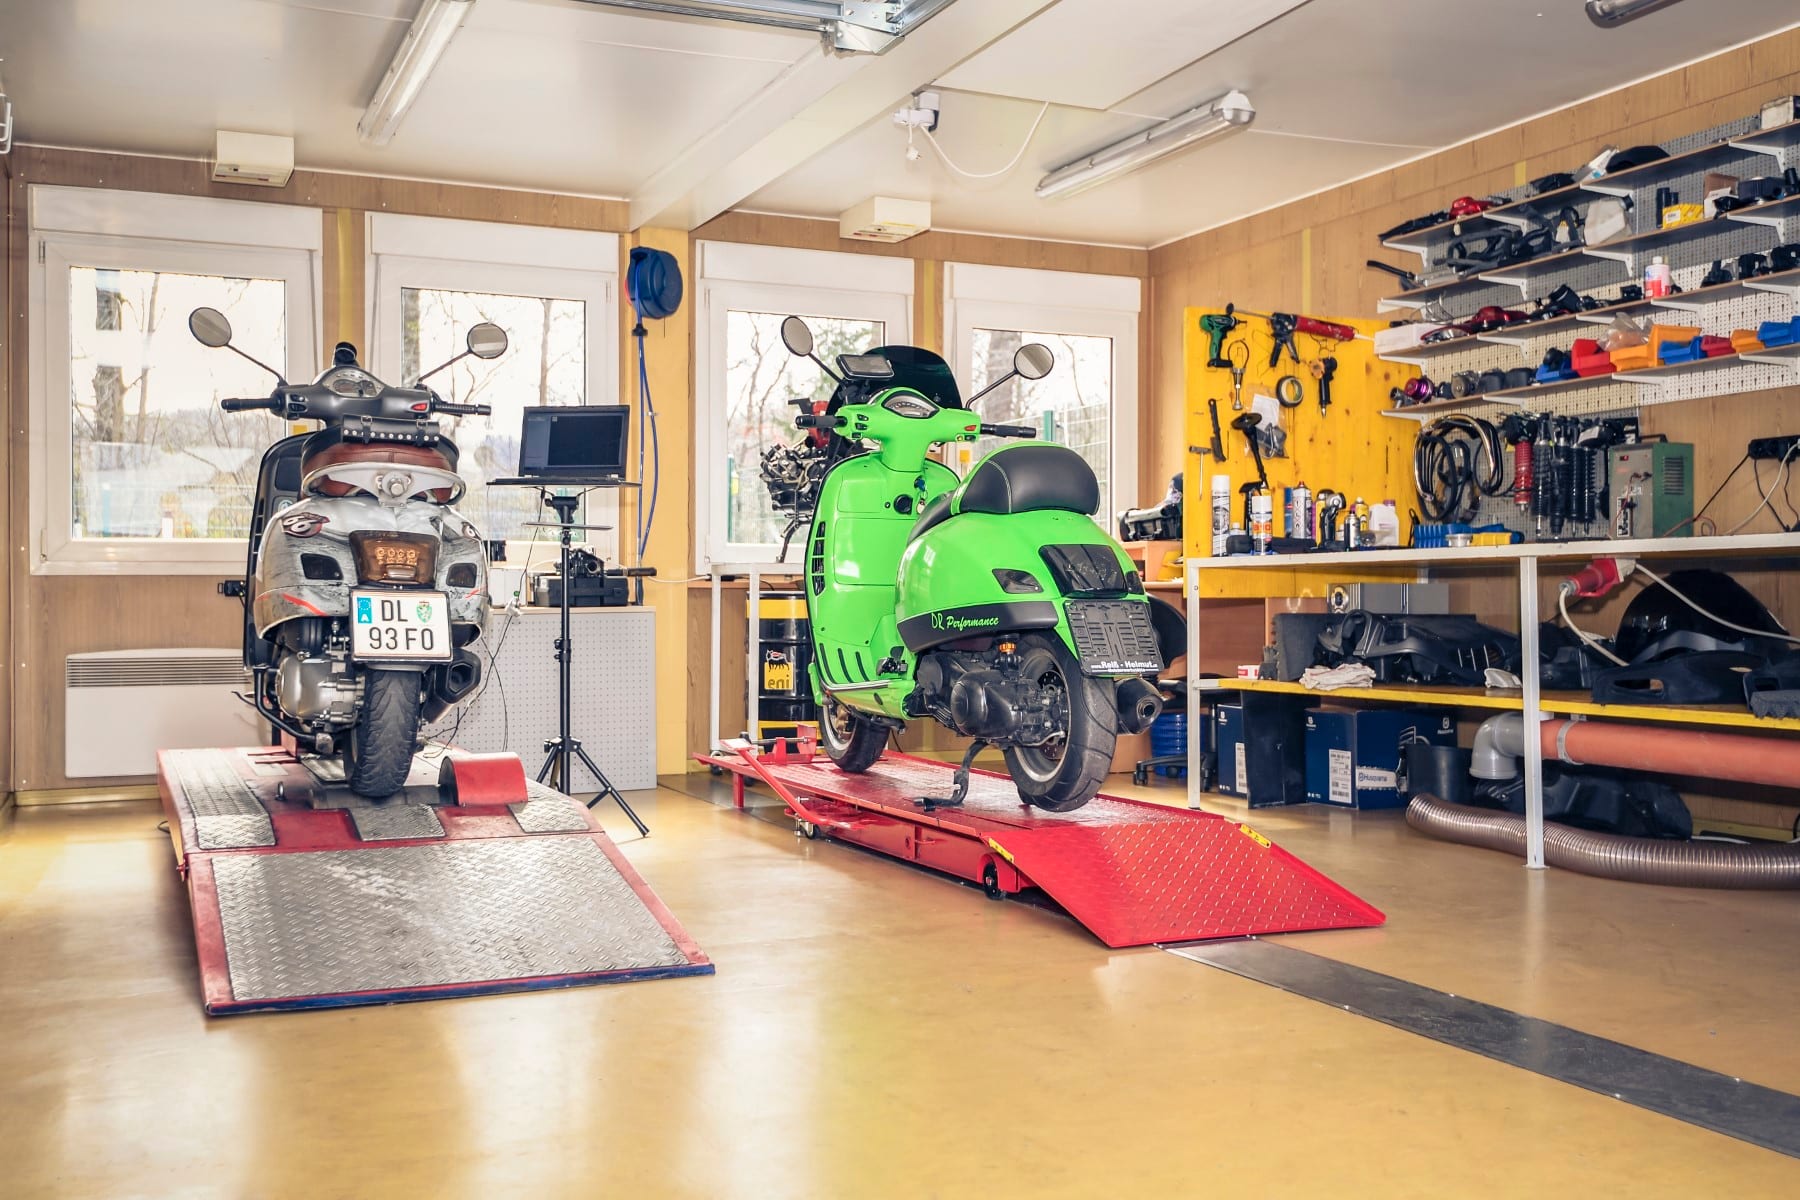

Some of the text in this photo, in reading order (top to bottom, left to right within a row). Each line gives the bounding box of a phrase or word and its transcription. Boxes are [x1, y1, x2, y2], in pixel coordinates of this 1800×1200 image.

[360, 613, 370, 622] A
[381, 599, 408, 622] DL
[946, 616, 999, 631] Performance
[369, 627, 398, 650] 93
[768, 674, 790, 689] eni
